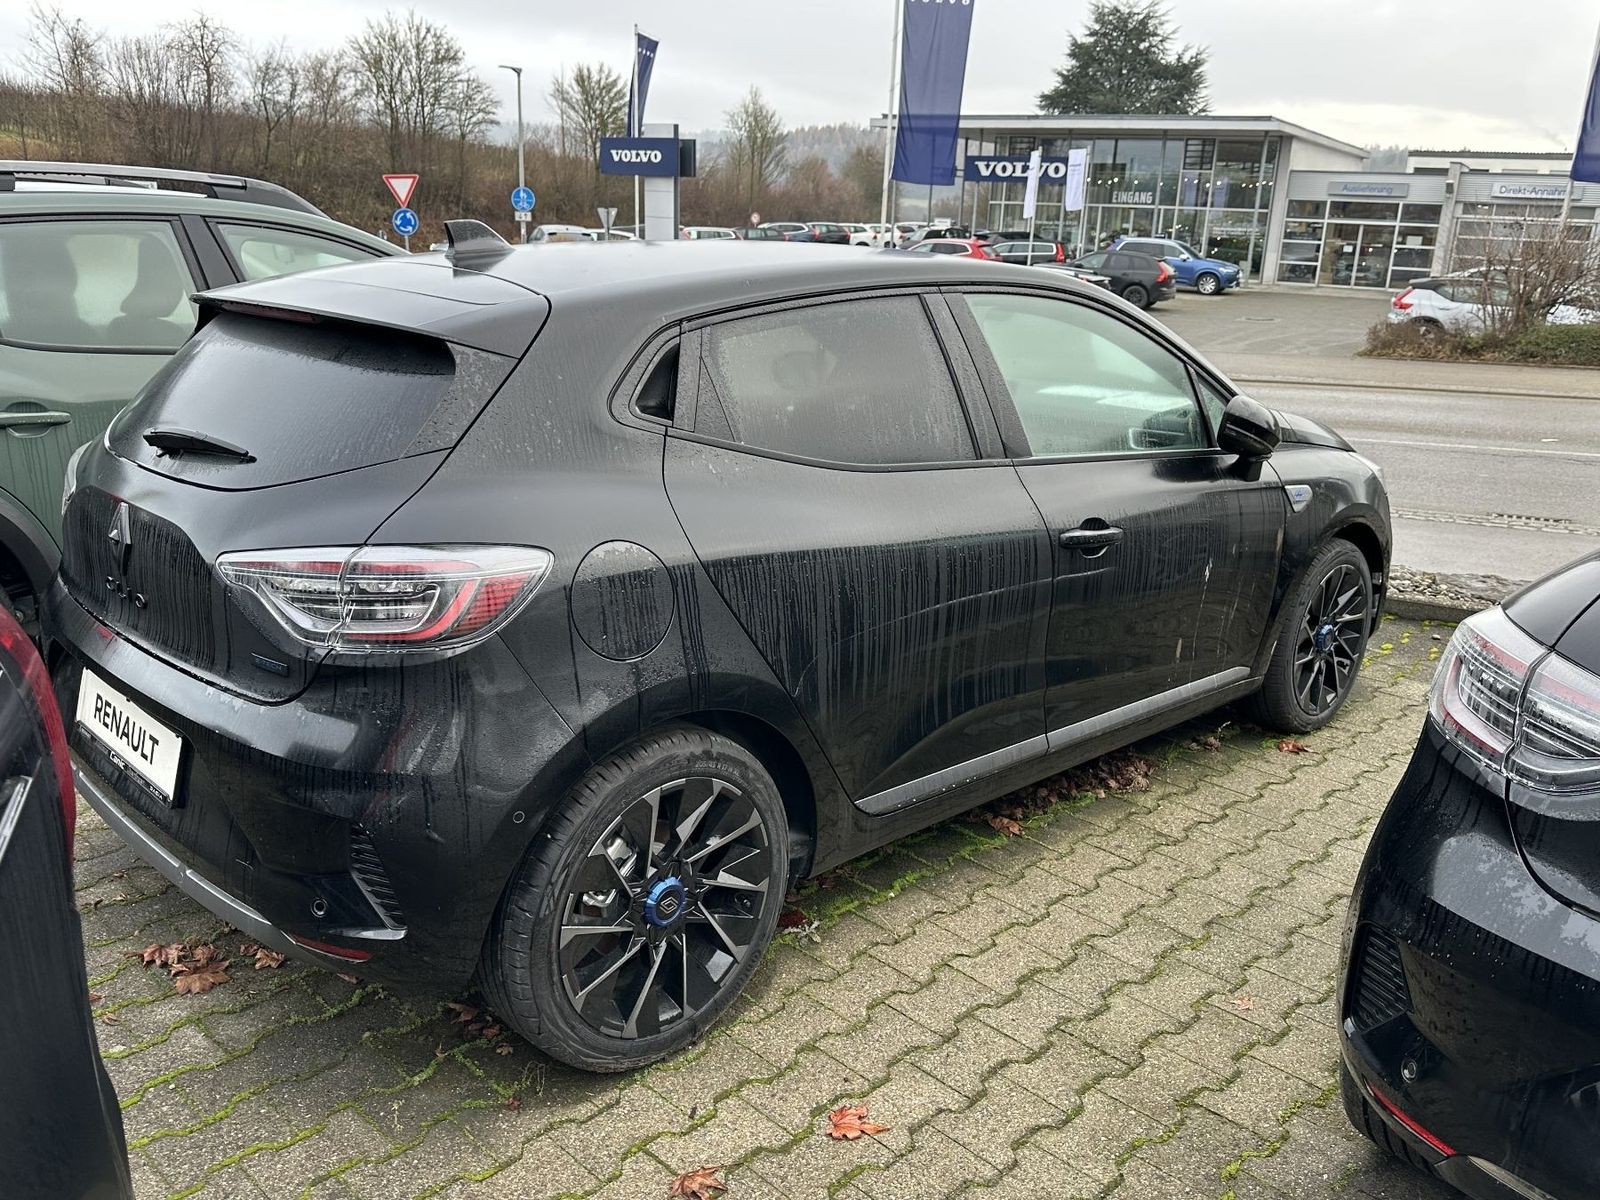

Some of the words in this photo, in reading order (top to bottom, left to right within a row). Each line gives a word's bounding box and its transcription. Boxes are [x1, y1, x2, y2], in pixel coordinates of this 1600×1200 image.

[610, 149, 662, 163] VOLVO
[1112, 191, 1153, 204] EINGANG
[94, 693, 159, 765] RENAULT
